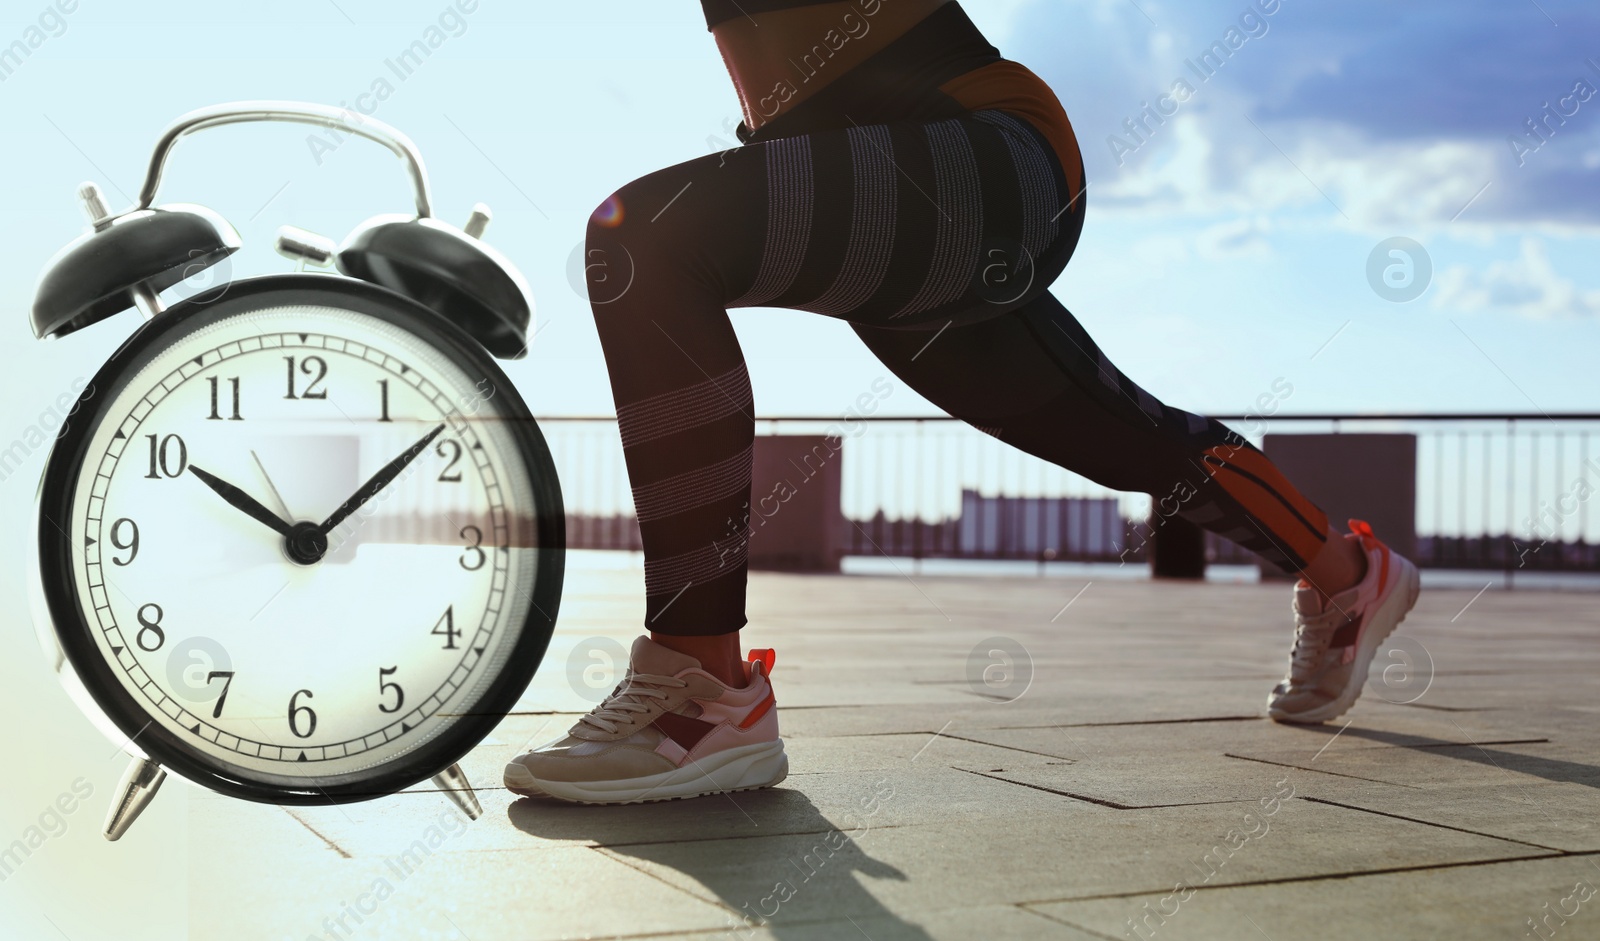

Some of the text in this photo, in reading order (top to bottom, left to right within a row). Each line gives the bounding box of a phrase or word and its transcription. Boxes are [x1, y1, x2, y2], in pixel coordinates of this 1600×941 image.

[205, 375, 245, 421] 11
[282, 356, 328, 400] 12
[376, 379, 393, 422] 1
[144, 433, 188, 479] 10
[436, 438, 463, 483] 2
[109, 517, 140, 566] 9
[458, 525, 486, 571] 3
[135, 603, 165, 652] 8
[431, 604, 463, 650] 4
[206, 670, 235, 719] 7
[378, 666, 405, 713] 5
[288, 689, 318, 738] 6
